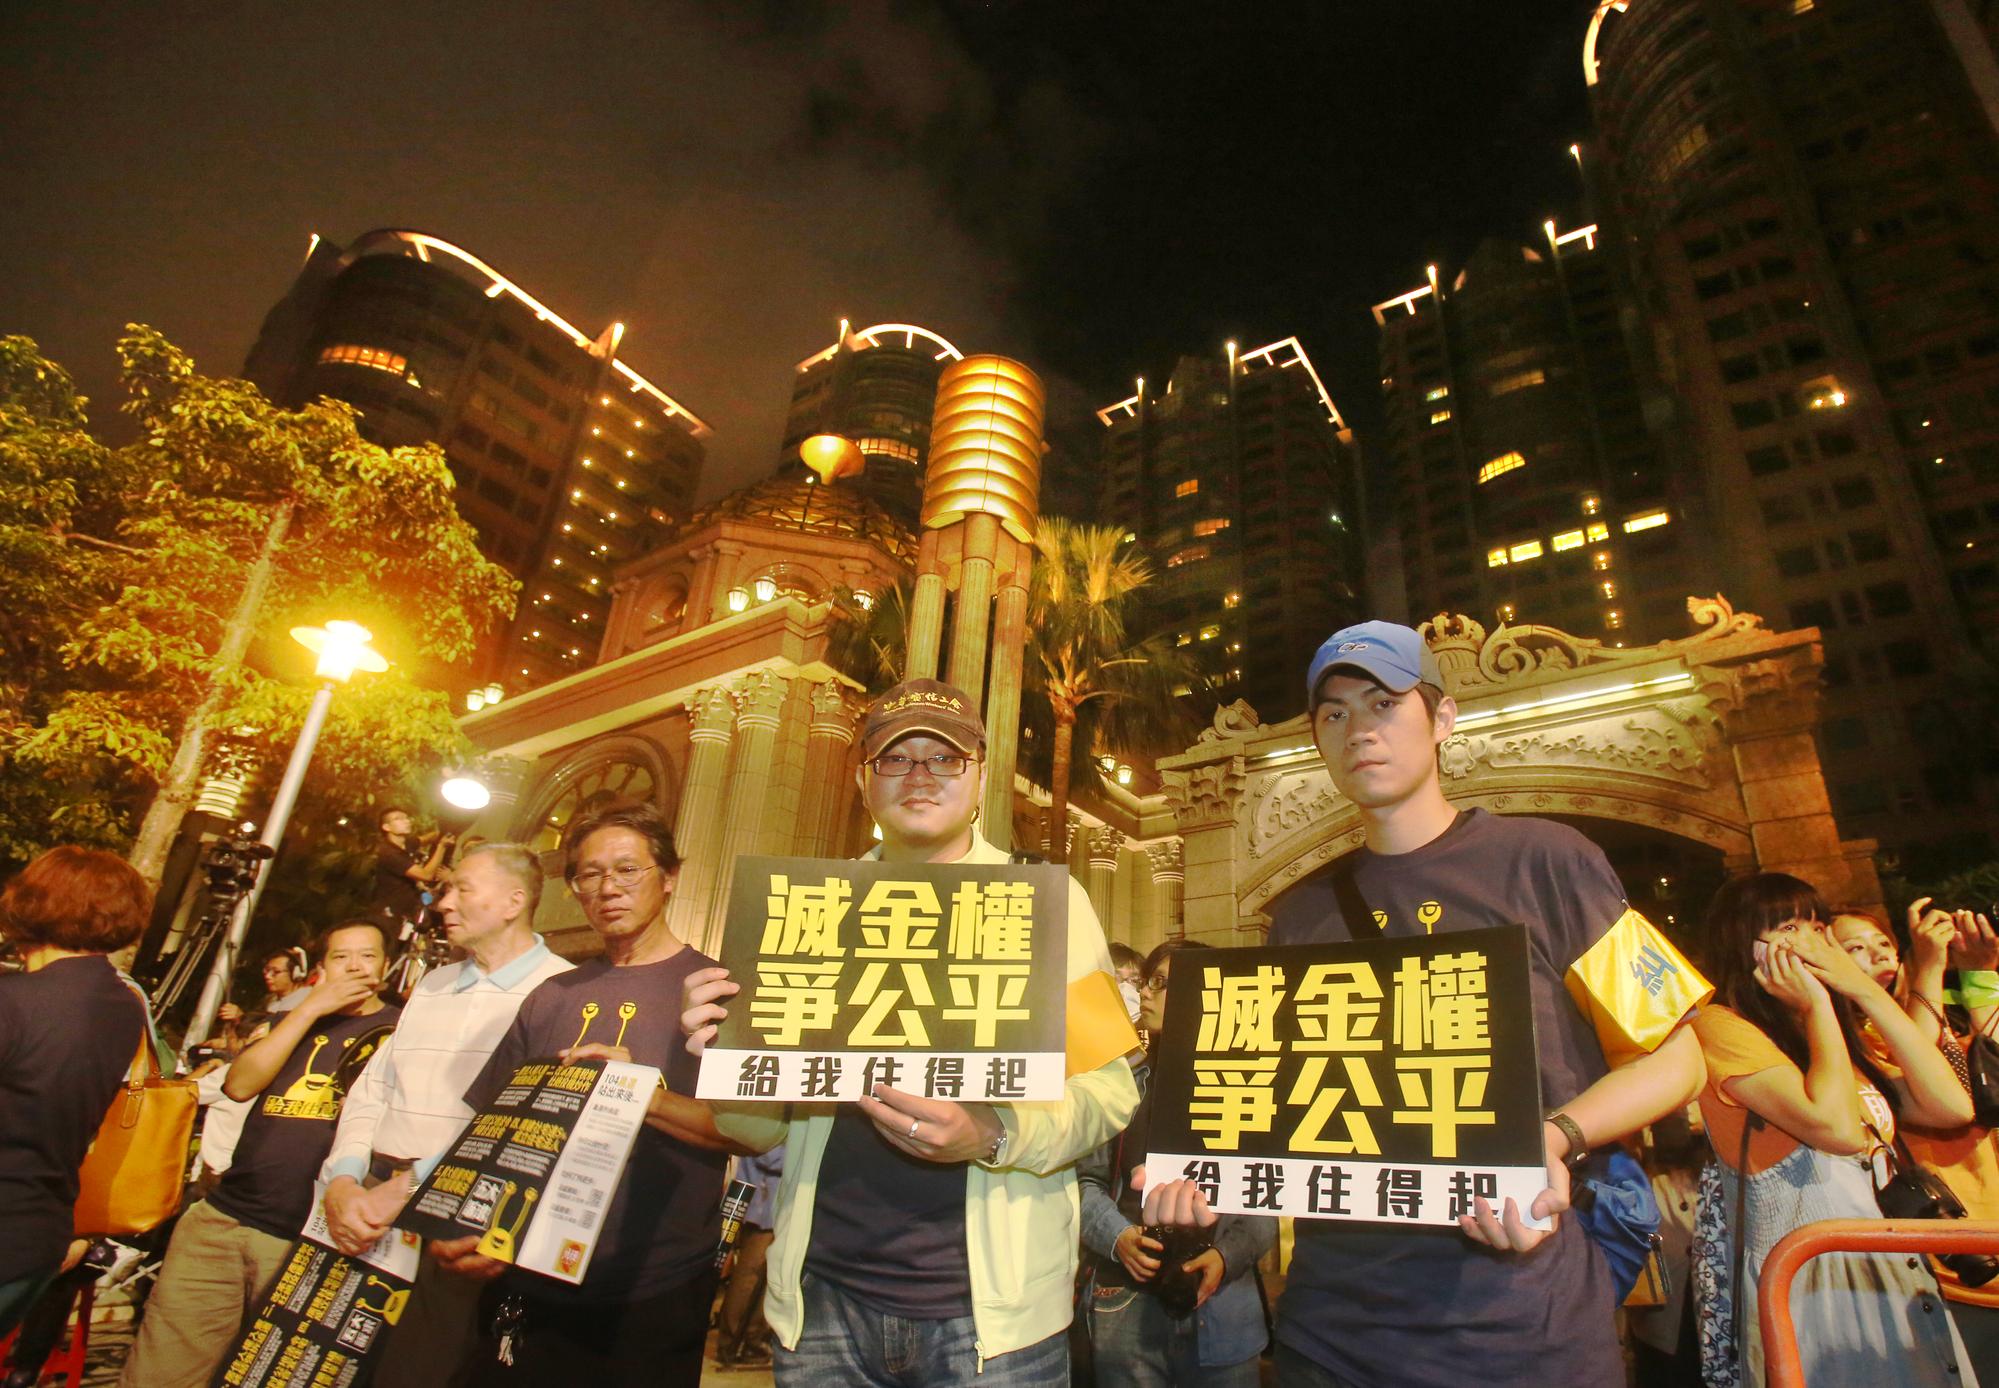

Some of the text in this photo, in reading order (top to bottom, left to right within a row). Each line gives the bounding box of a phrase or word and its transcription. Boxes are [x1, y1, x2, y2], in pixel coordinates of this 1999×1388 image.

[759, 874, 1035, 961] 滅金權
[750, 962, 1032, 1048] 爭公平
[1195, 952, 1491, 1051] 滅金權
[1630, 945, 1678, 996] 糾
[736, 1054, 1028, 1099] 給我住得起
[1189, 1056, 1496, 1157] 爭公平
[1182, 1160, 1500, 1222] 給我住得起
